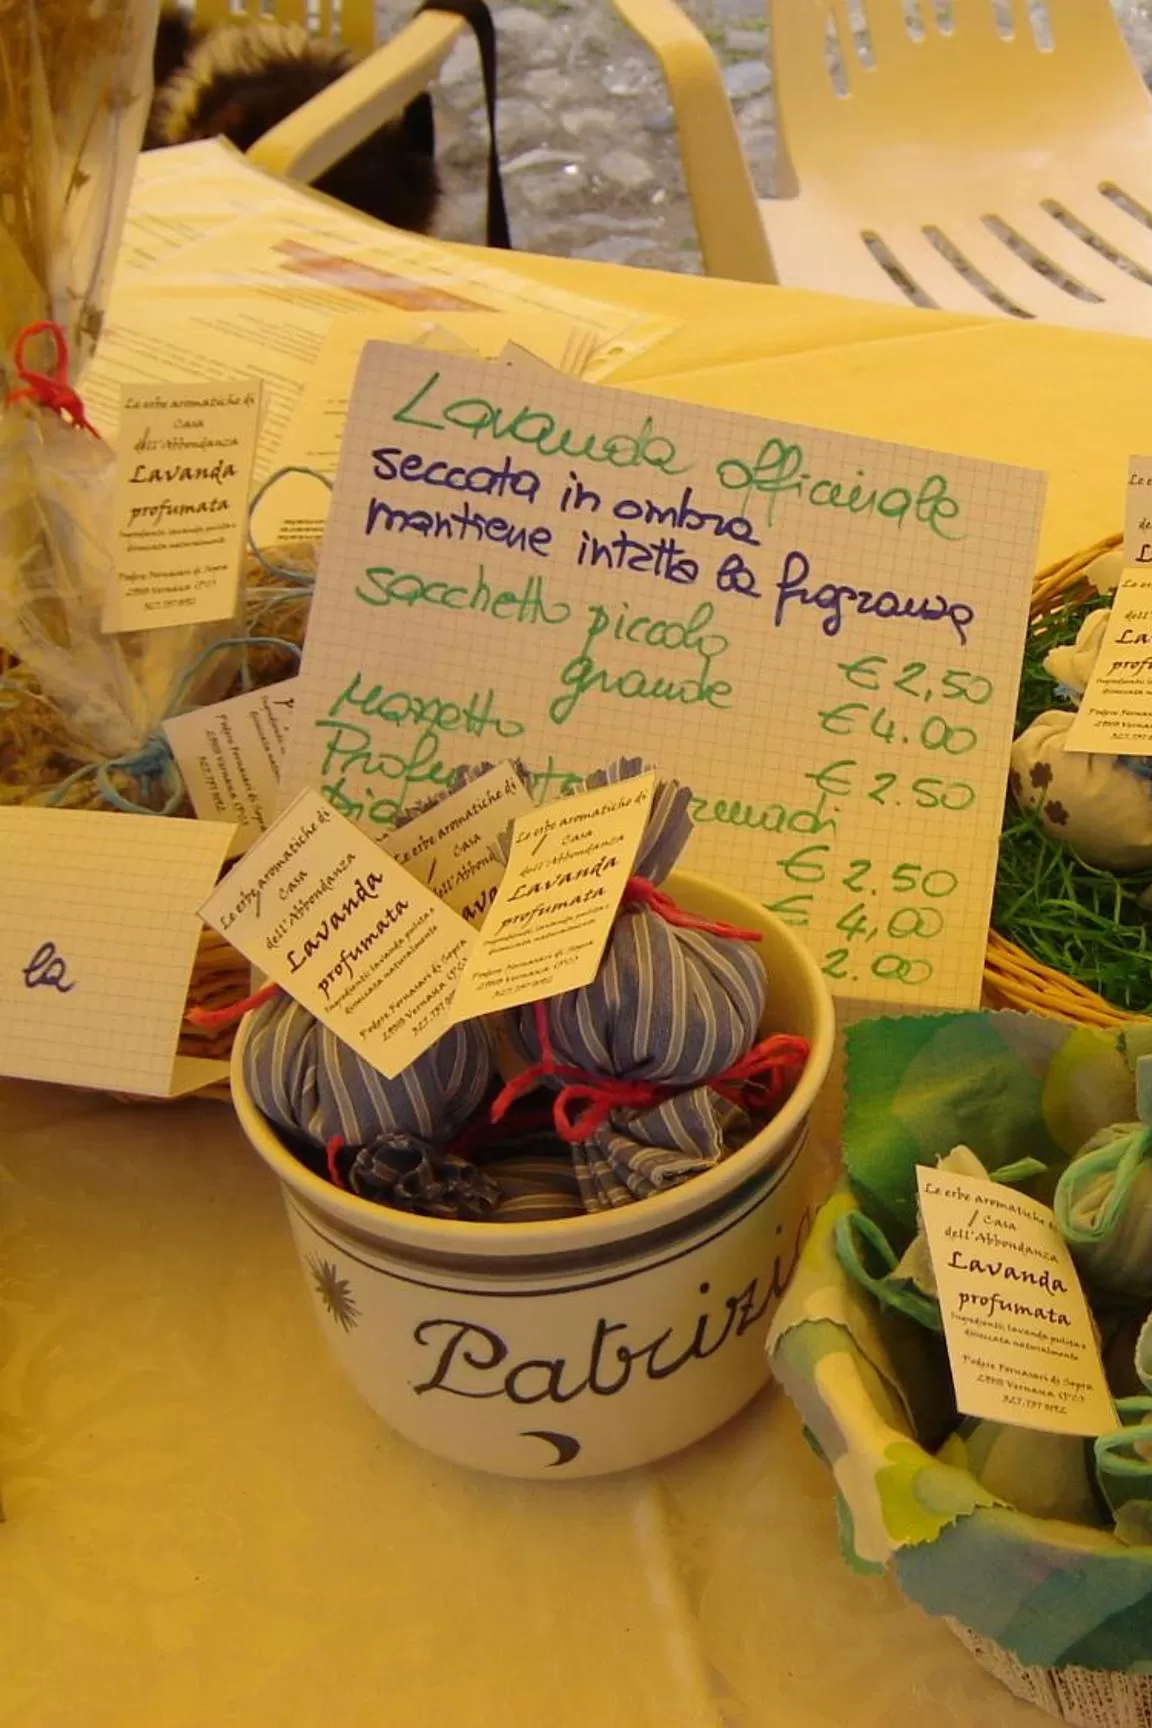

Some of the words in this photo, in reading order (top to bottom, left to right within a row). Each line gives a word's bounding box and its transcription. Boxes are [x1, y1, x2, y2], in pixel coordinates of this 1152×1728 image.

[393, 371, 698, 476] Lavanda
[129, 460, 236, 485] Lavanda
[373, 448, 540, 505] seccata
[561, 472, 600, 513] in
[613, 487, 760, 547] ombra
[1128, 474, 1145, 486] Le
[128, 498, 229, 526] profumata
[366, 498, 552, 557] mantiene
[588, 600, 730, 662] piccolo
[550, 655, 732, 723] grande
[413, 832, 437, 856] erbe
[437, 789, 501, 843] aromatiche
[505, 776, 518, 797] di
[258, 824, 318, 888] aromatiche
[453, 833, 482, 857] Casa
[279, 869, 309, 902] Casa
[507, 855, 620, 904] Lavanda
[286, 870, 384, 974] Lavanda
[495, 886, 606, 937] profumata
[317, 899, 410, 1000] profumata
[924, 1182, 943, 1195] Le
[945, 1185, 972, 1202] erbe
[975, 1194, 1045, 1225] aromatiche
[983, 1215, 1017, 1231] Casa
[948, 1251, 1068, 1298] Lavanda
[413, 1224, 800, 1404] Patrizi
[957, 1290, 1072, 1327] profumata
